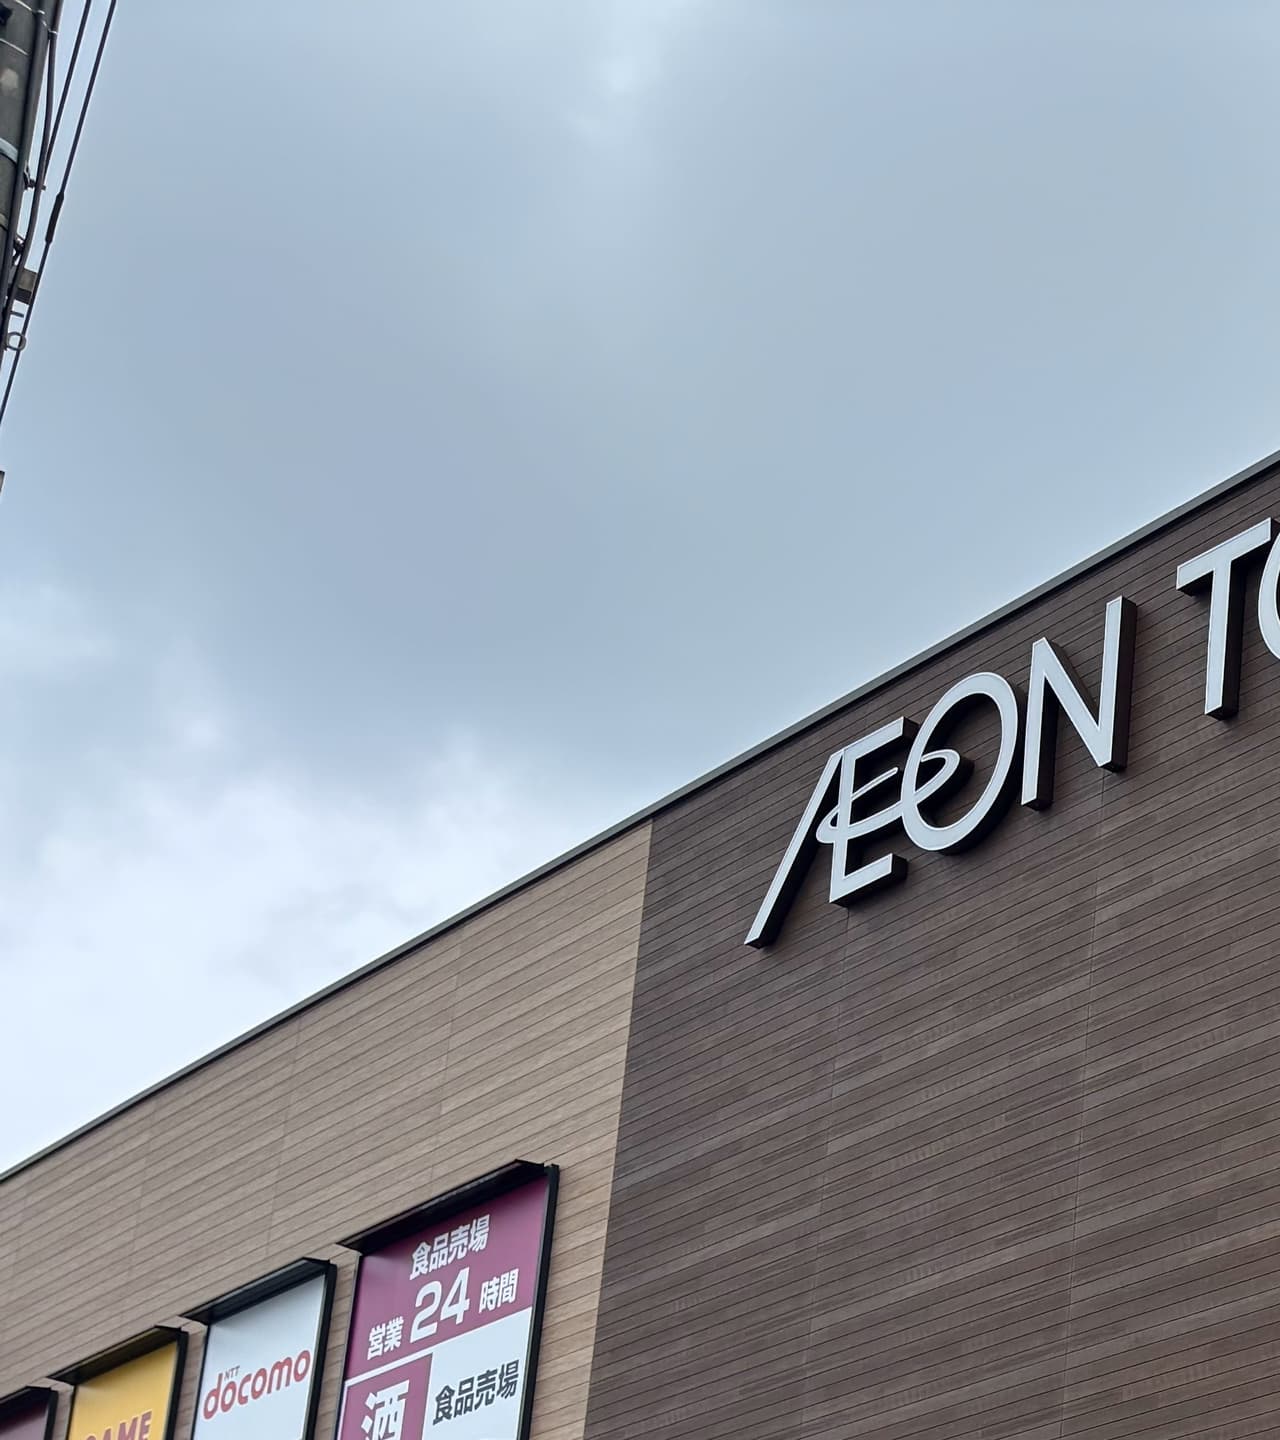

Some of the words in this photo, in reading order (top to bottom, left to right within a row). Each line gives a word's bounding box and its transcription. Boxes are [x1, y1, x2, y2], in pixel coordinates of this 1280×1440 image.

[409, 1213, 490, 1281] 食品売場
[203, 1349, 311, 1420] docomo
[224, 1365, 240, 1380] NTT
[432, 1359, 519, 1426] 食品売場
